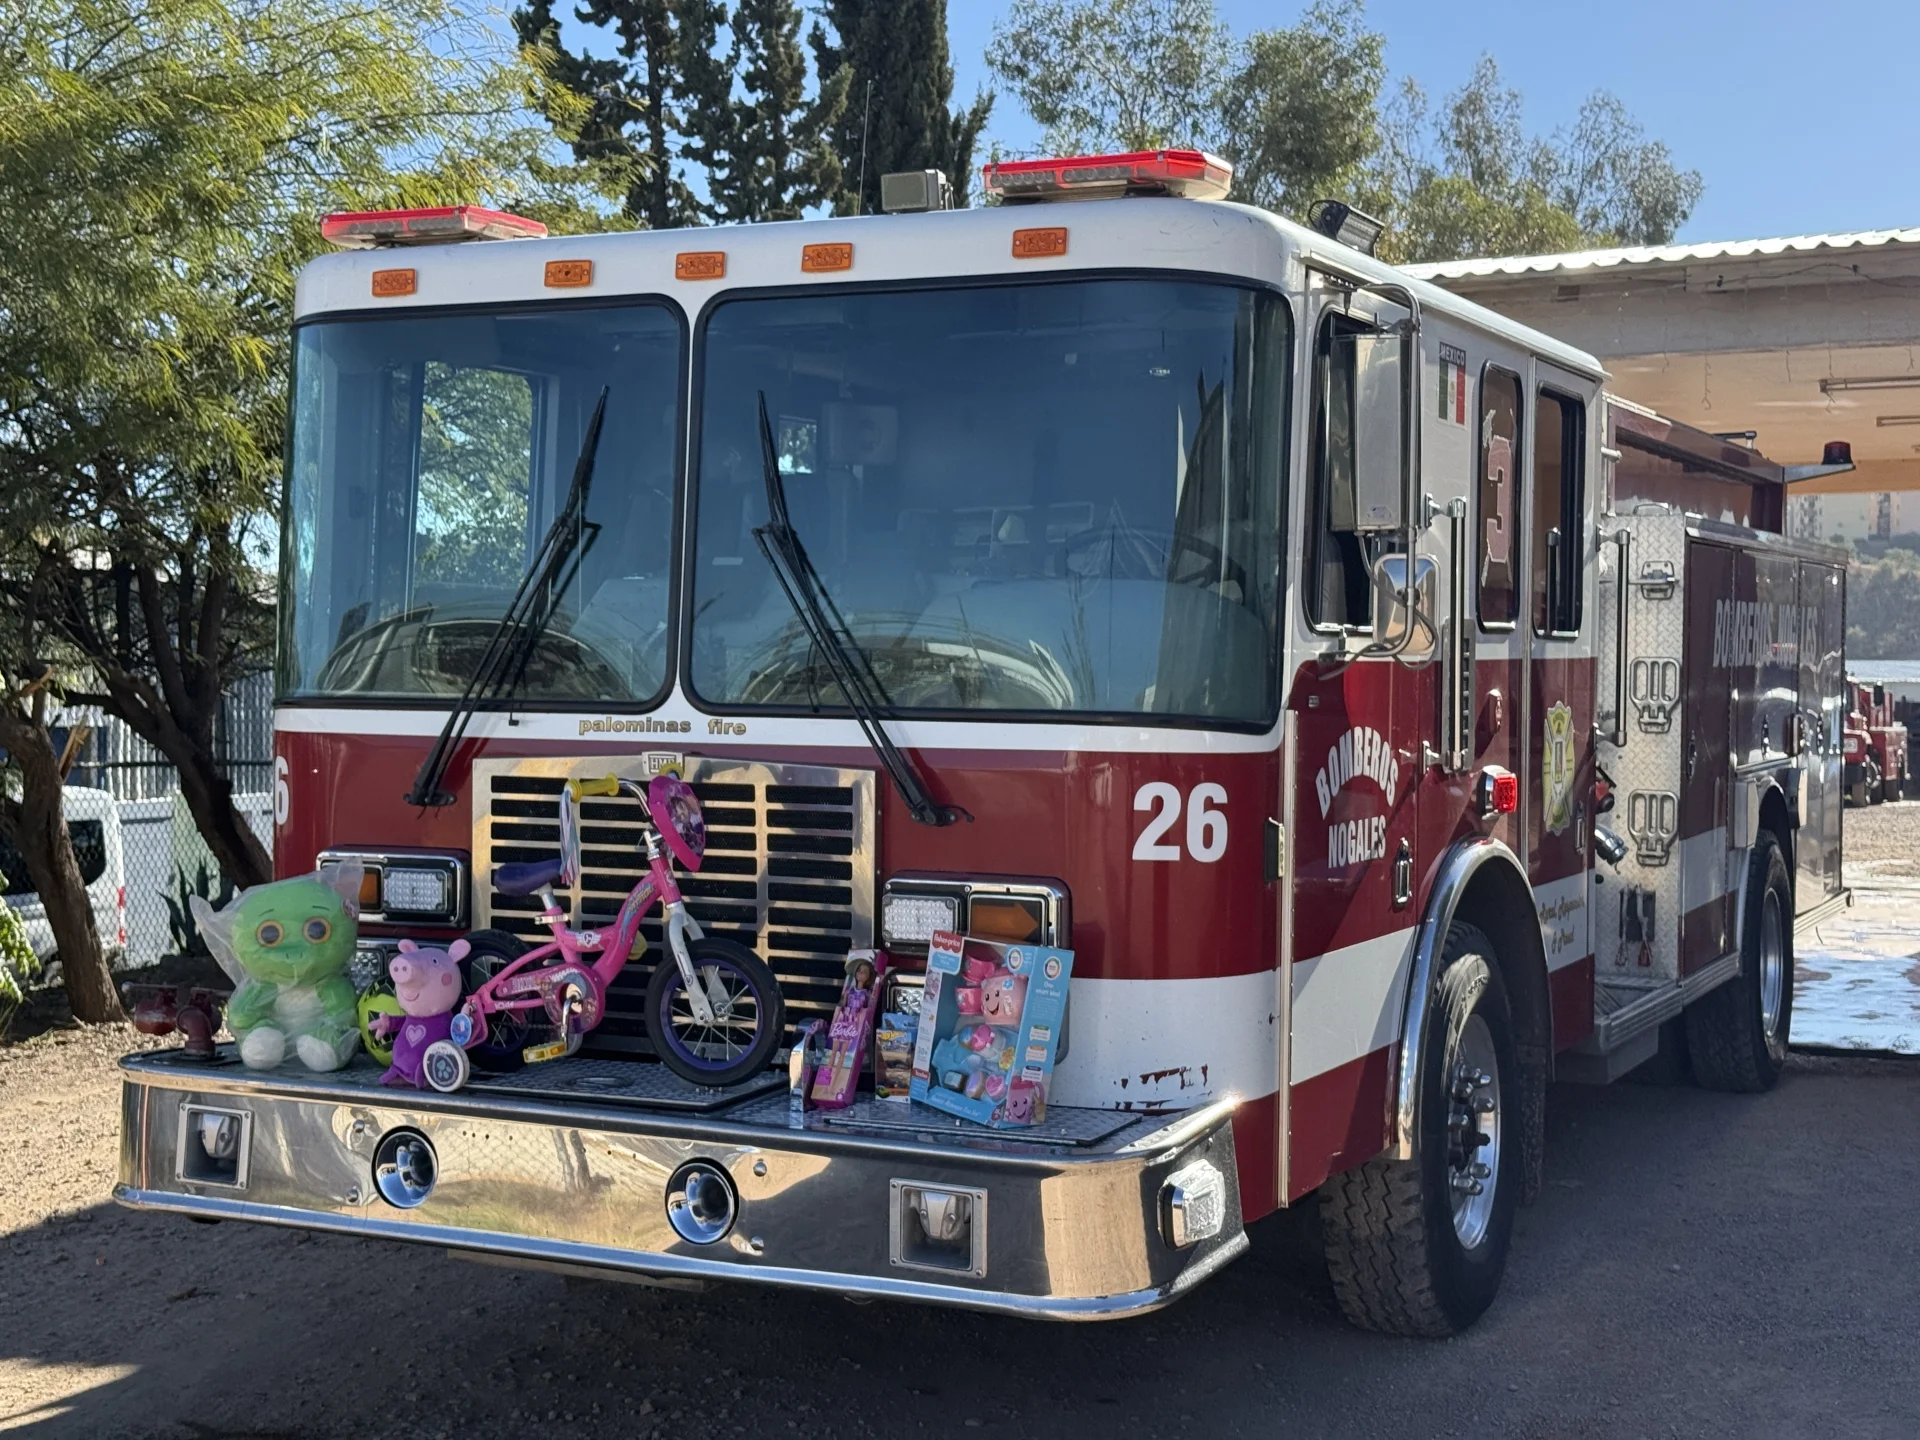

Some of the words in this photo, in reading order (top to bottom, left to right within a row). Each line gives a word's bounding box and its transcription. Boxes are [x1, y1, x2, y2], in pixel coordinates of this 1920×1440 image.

[1440, 343, 1465, 366] MEXICO
[1487, 434, 1511, 564] 3
[578, 717, 692, 736] palominas
[708, 718, 747, 736] fire
[1315, 726, 1399, 820] BOMBEROS
[1132, 781, 1228, 863] 26
[1328, 814, 1387, 869] NOGALES
[830, 1022, 859, 1037] Barbie
